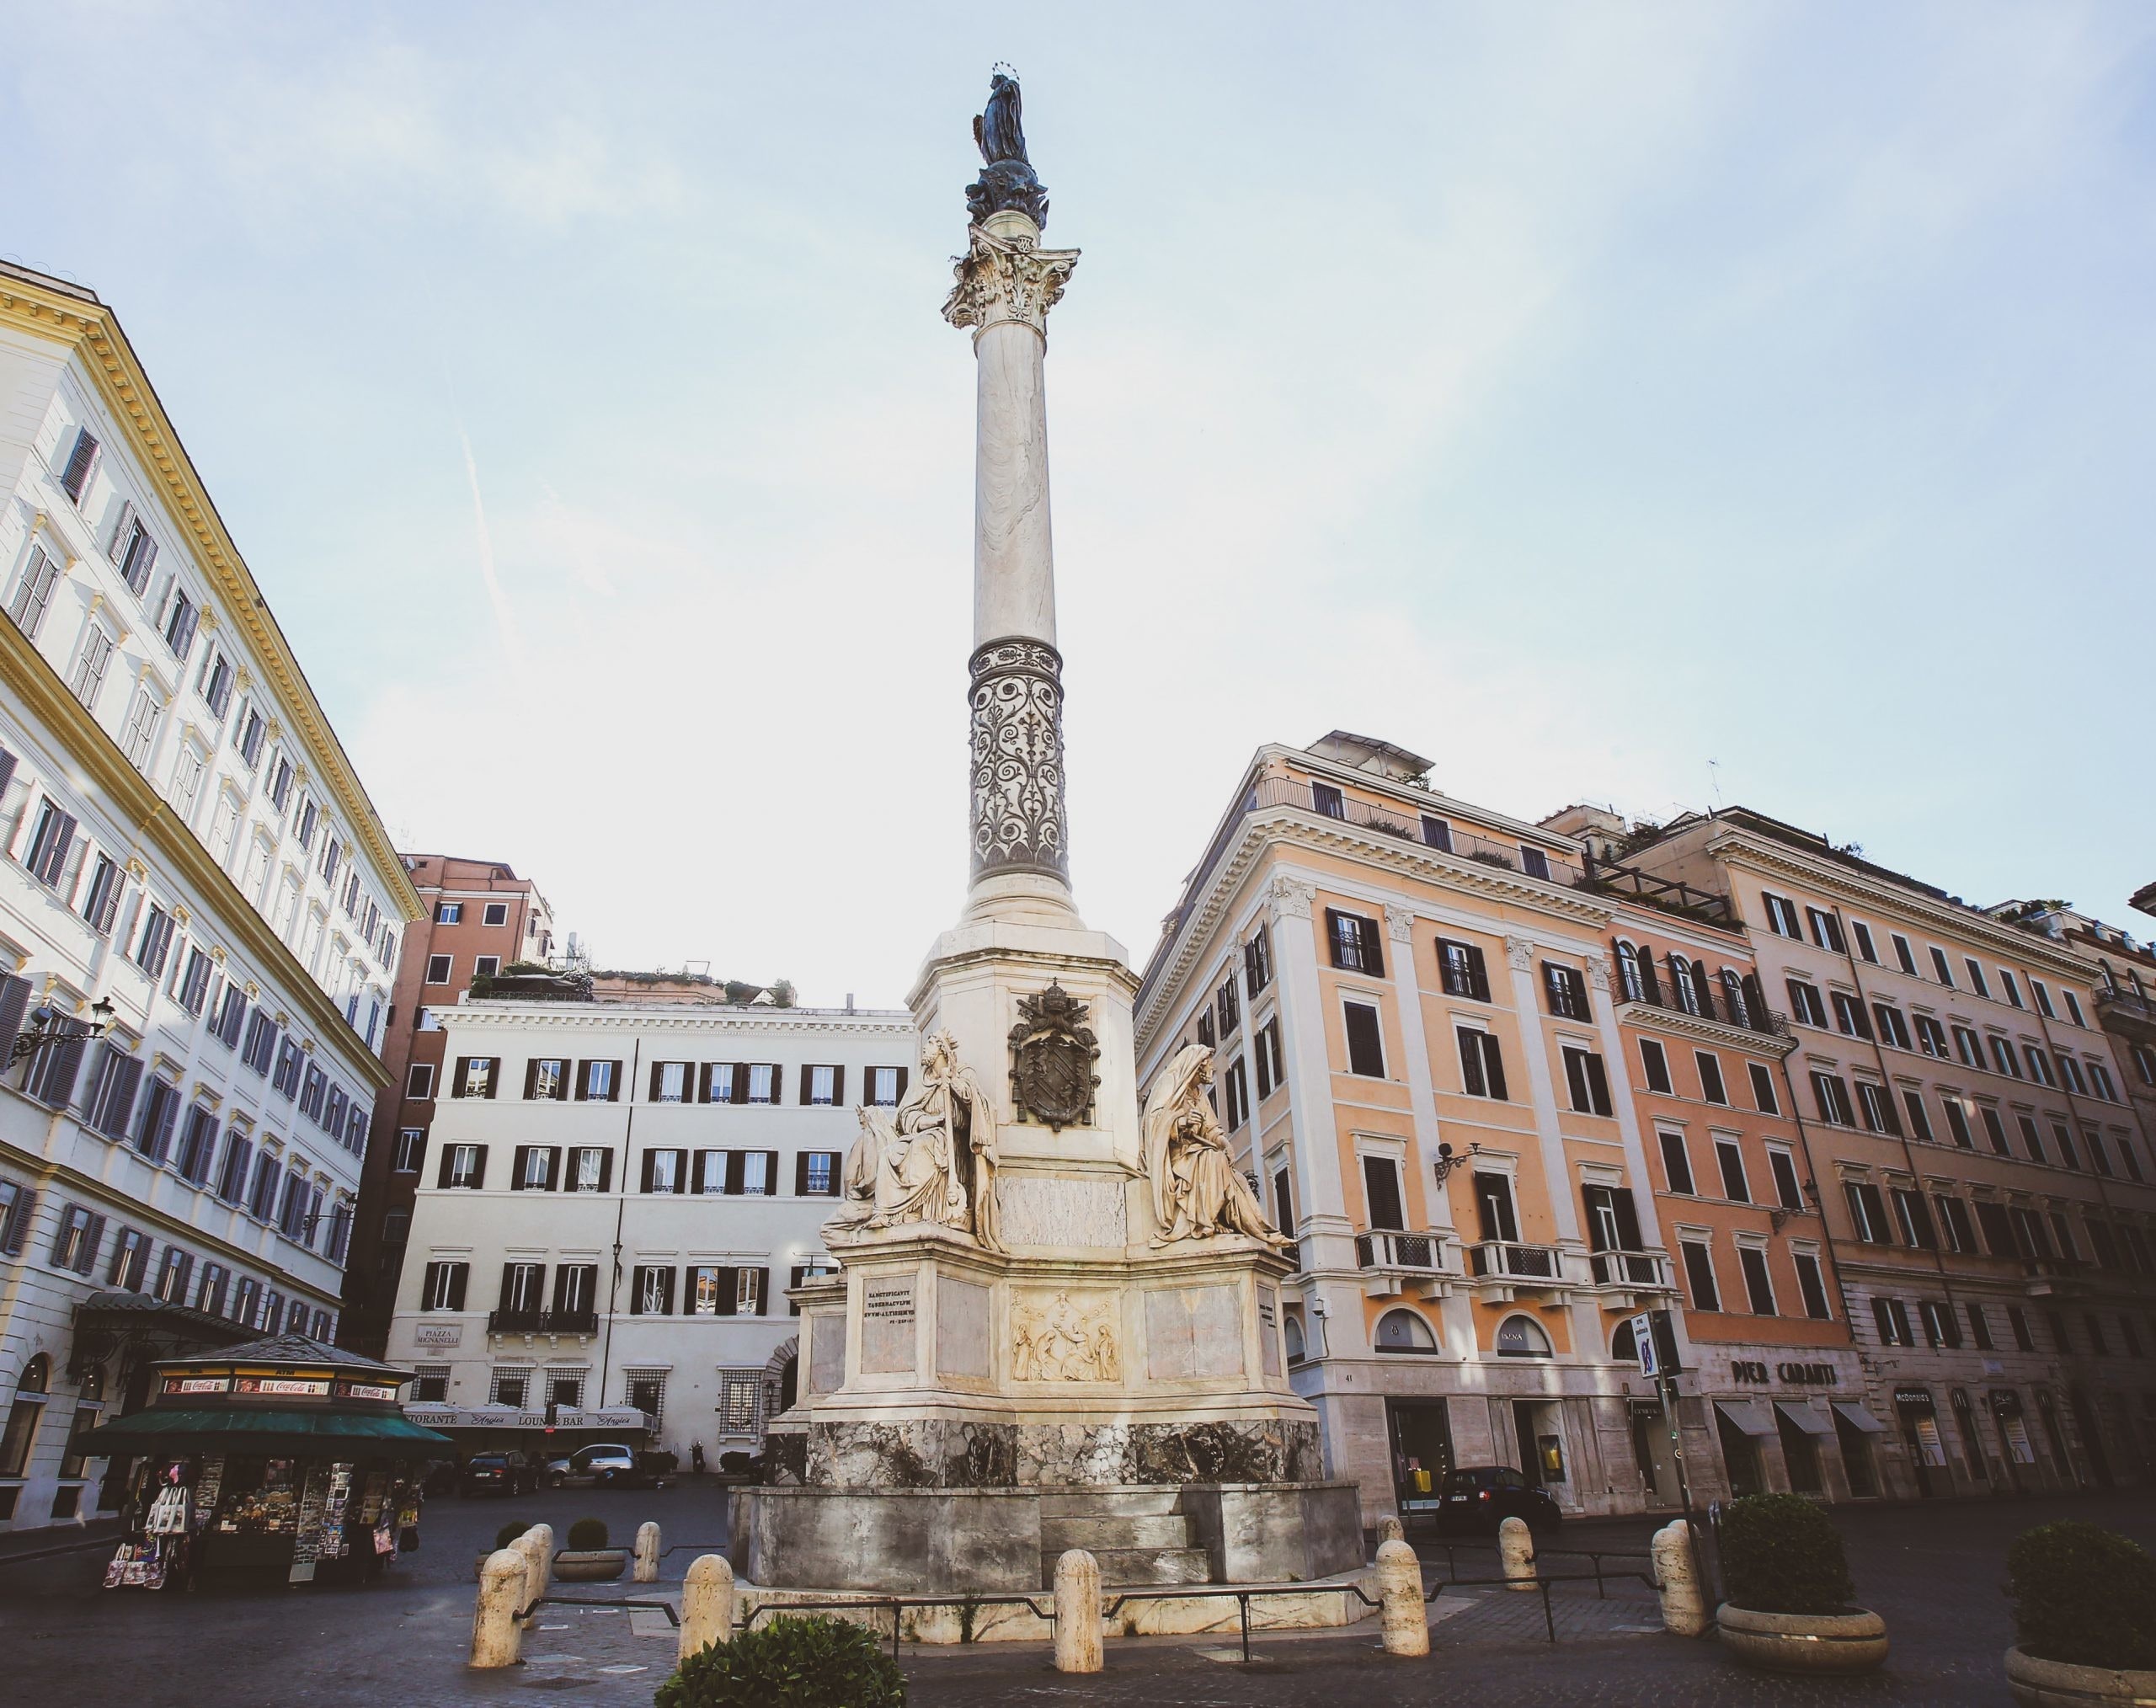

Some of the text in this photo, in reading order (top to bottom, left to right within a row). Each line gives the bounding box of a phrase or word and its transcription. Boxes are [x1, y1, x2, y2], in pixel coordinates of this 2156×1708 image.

[1731, 1360, 1769, 1383] PIER
[276, 1382, 305, 1392] Coca-Cola
[519, 1417, 560, 1426] LOUNE
[563, 1417, 584, 1426] BAR
